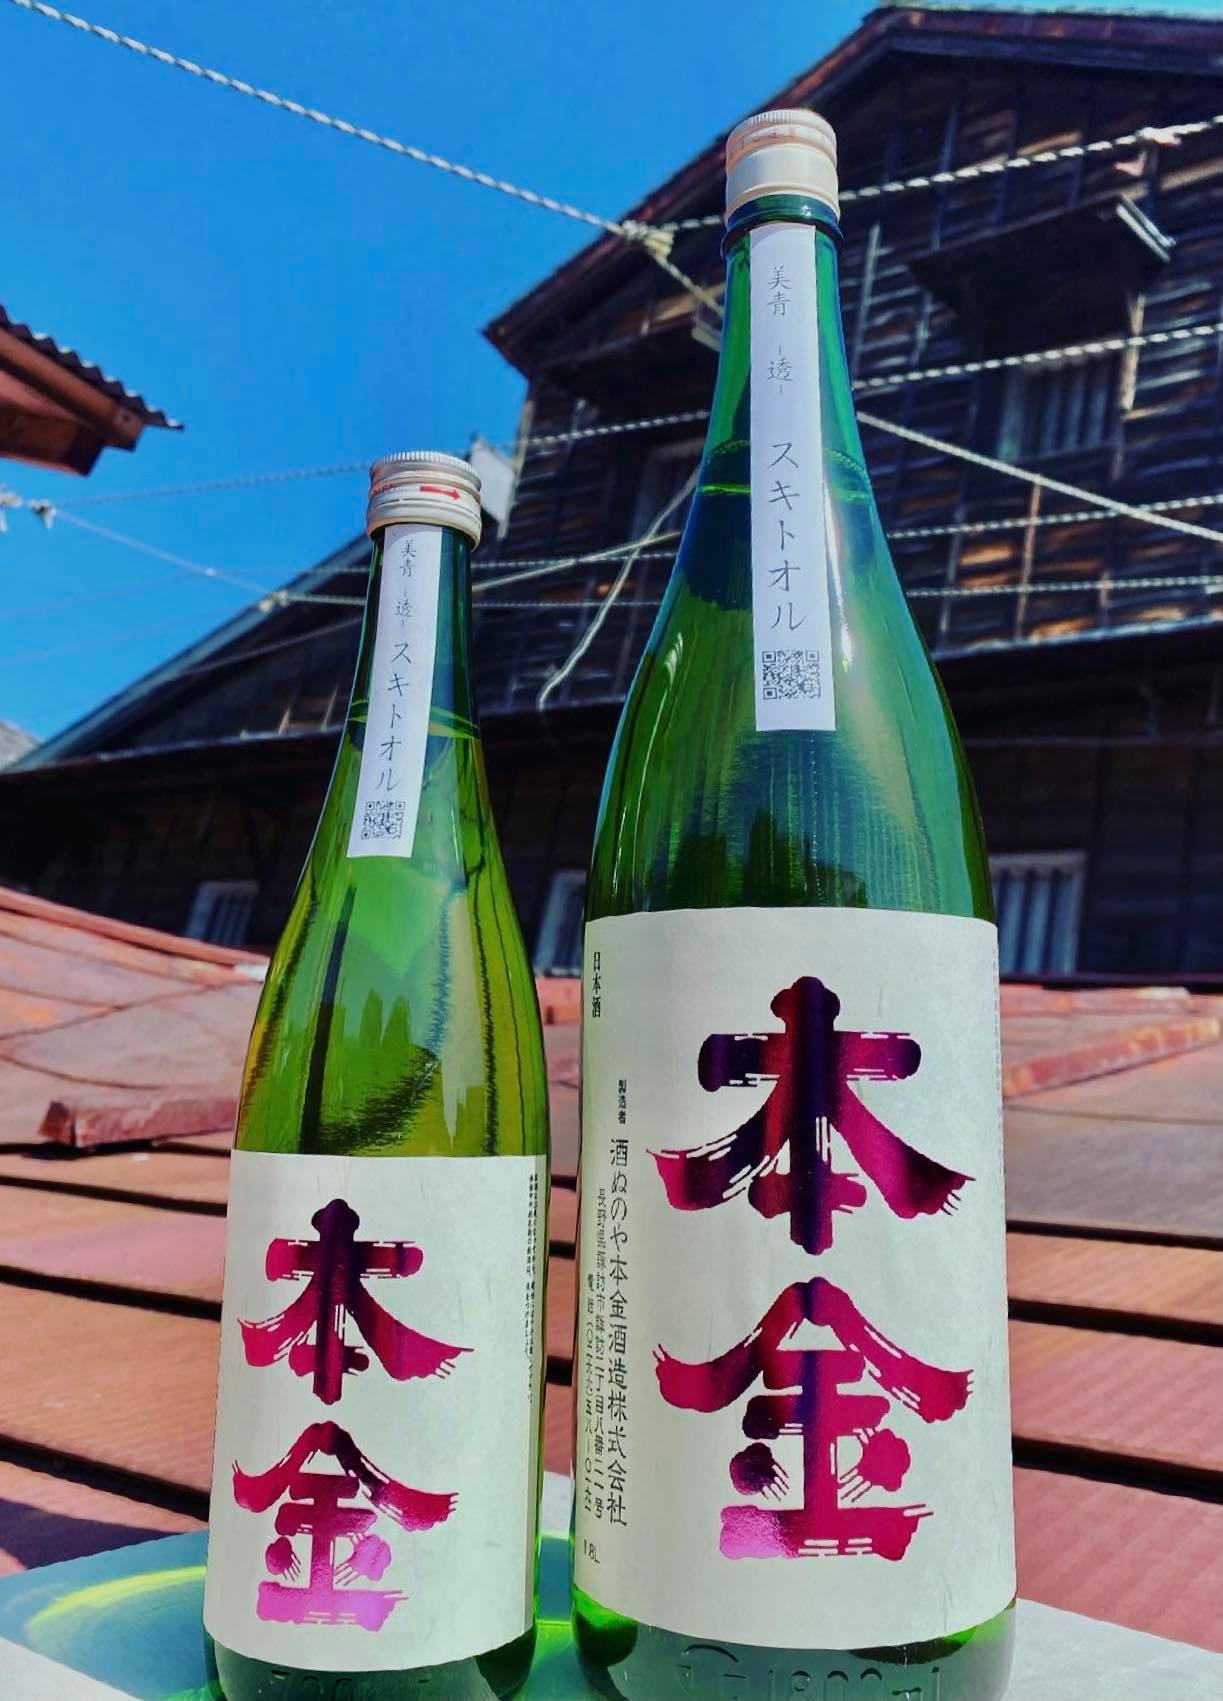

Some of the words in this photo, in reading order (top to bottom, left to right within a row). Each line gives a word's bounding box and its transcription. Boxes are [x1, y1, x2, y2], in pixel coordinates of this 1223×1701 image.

[767, 264, 792, 317] 美青
[768, 442, 806, 632] スキトオル
[374, 642, 412, 792] スキトオル
[591, 951, 602, 1018] 日本酒
[646, 976, 976, 1561] 本金
[233, 1198, 475, 1632] 本金
